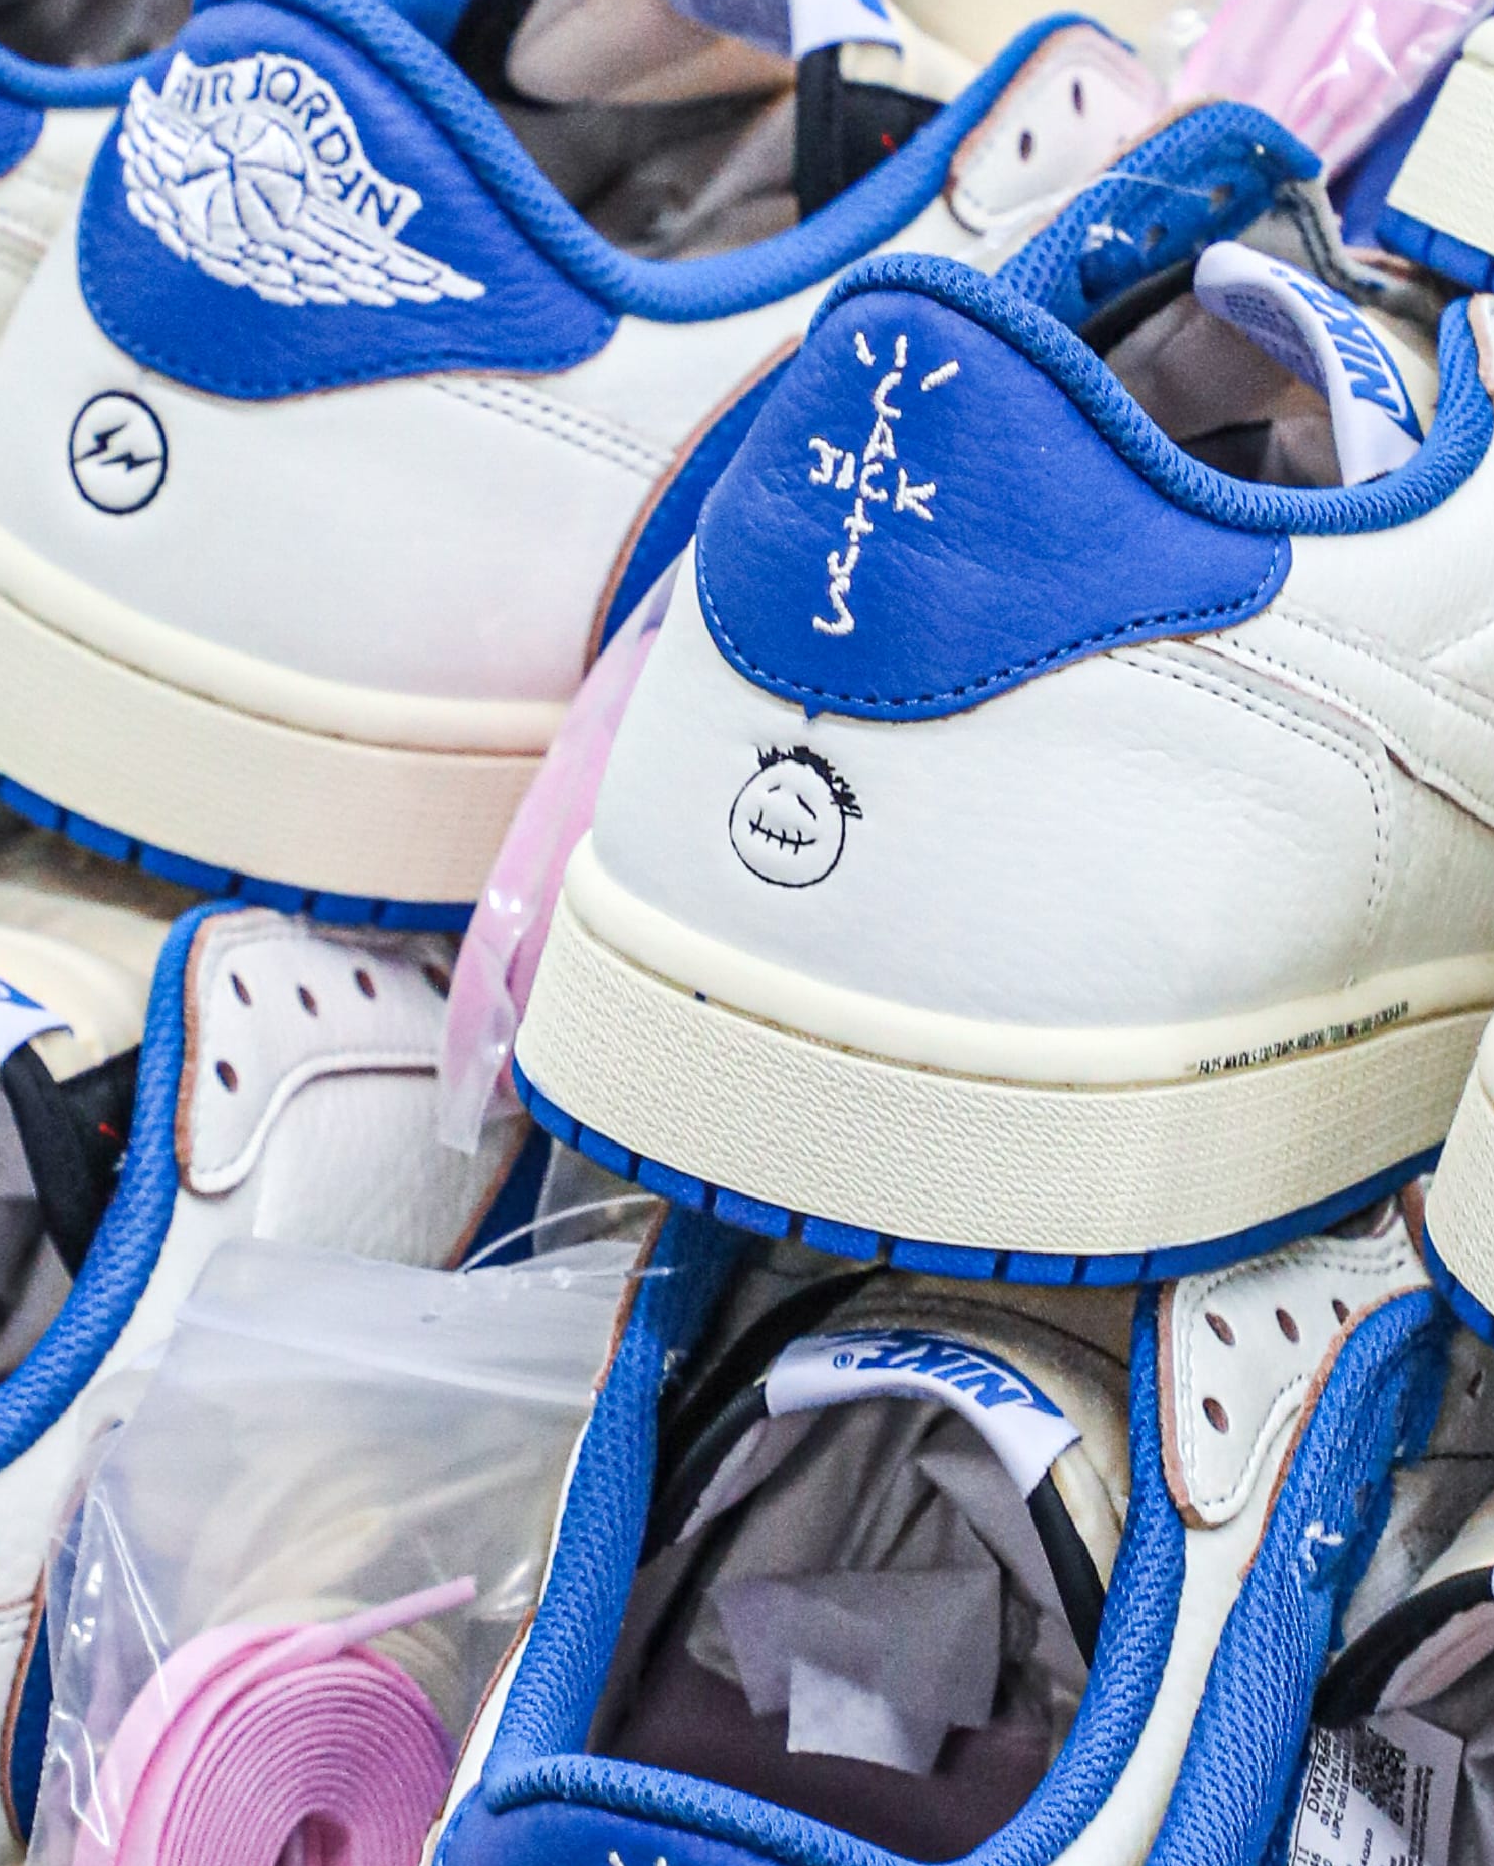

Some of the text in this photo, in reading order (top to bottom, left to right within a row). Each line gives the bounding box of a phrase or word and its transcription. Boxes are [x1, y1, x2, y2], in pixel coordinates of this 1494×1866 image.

[174, 62, 402, 228] AIR JORDAN
[1287, 280, 1402, 415] NIKE
[857, 1340, 1029, 1409] NIKE
[1296, 1846, 1310, 1865] 11
